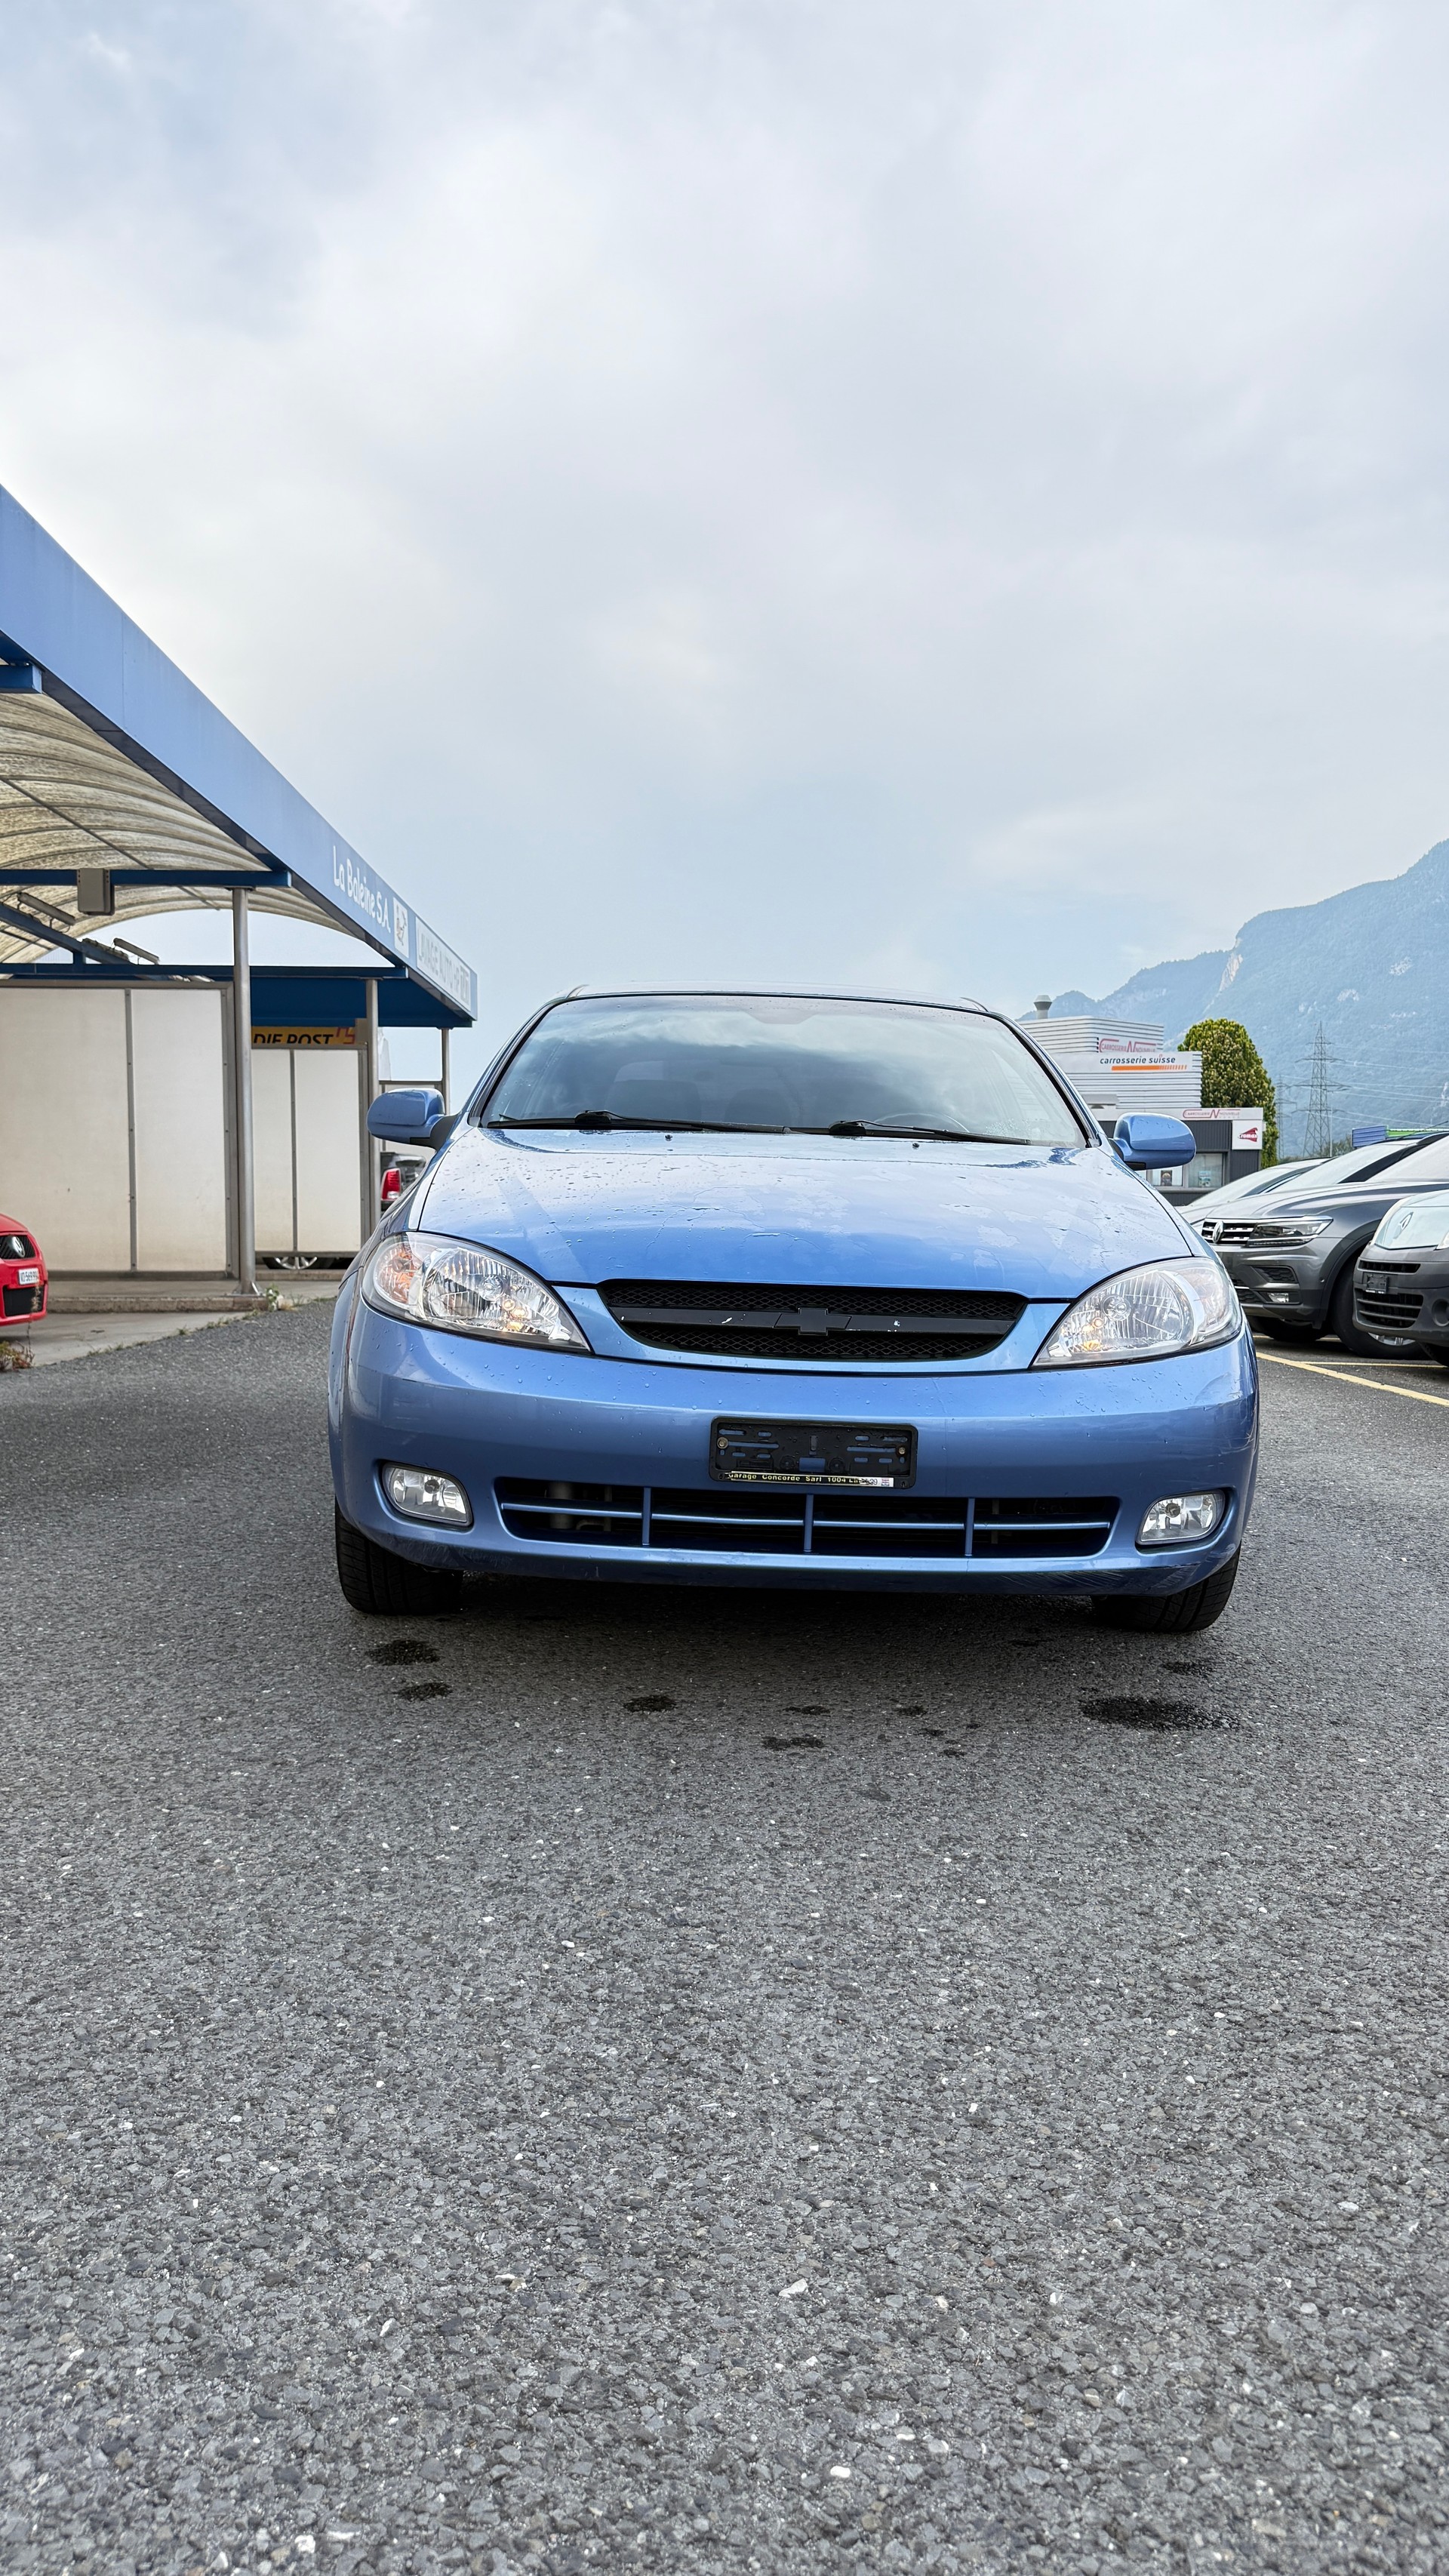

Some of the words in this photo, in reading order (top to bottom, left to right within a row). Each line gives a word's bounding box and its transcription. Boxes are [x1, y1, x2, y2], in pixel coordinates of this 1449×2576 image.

[333, 845, 345, 892] La
[346, 858, 376, 919] Baleine
[1149, 1054, 1176, 1063] suisse
